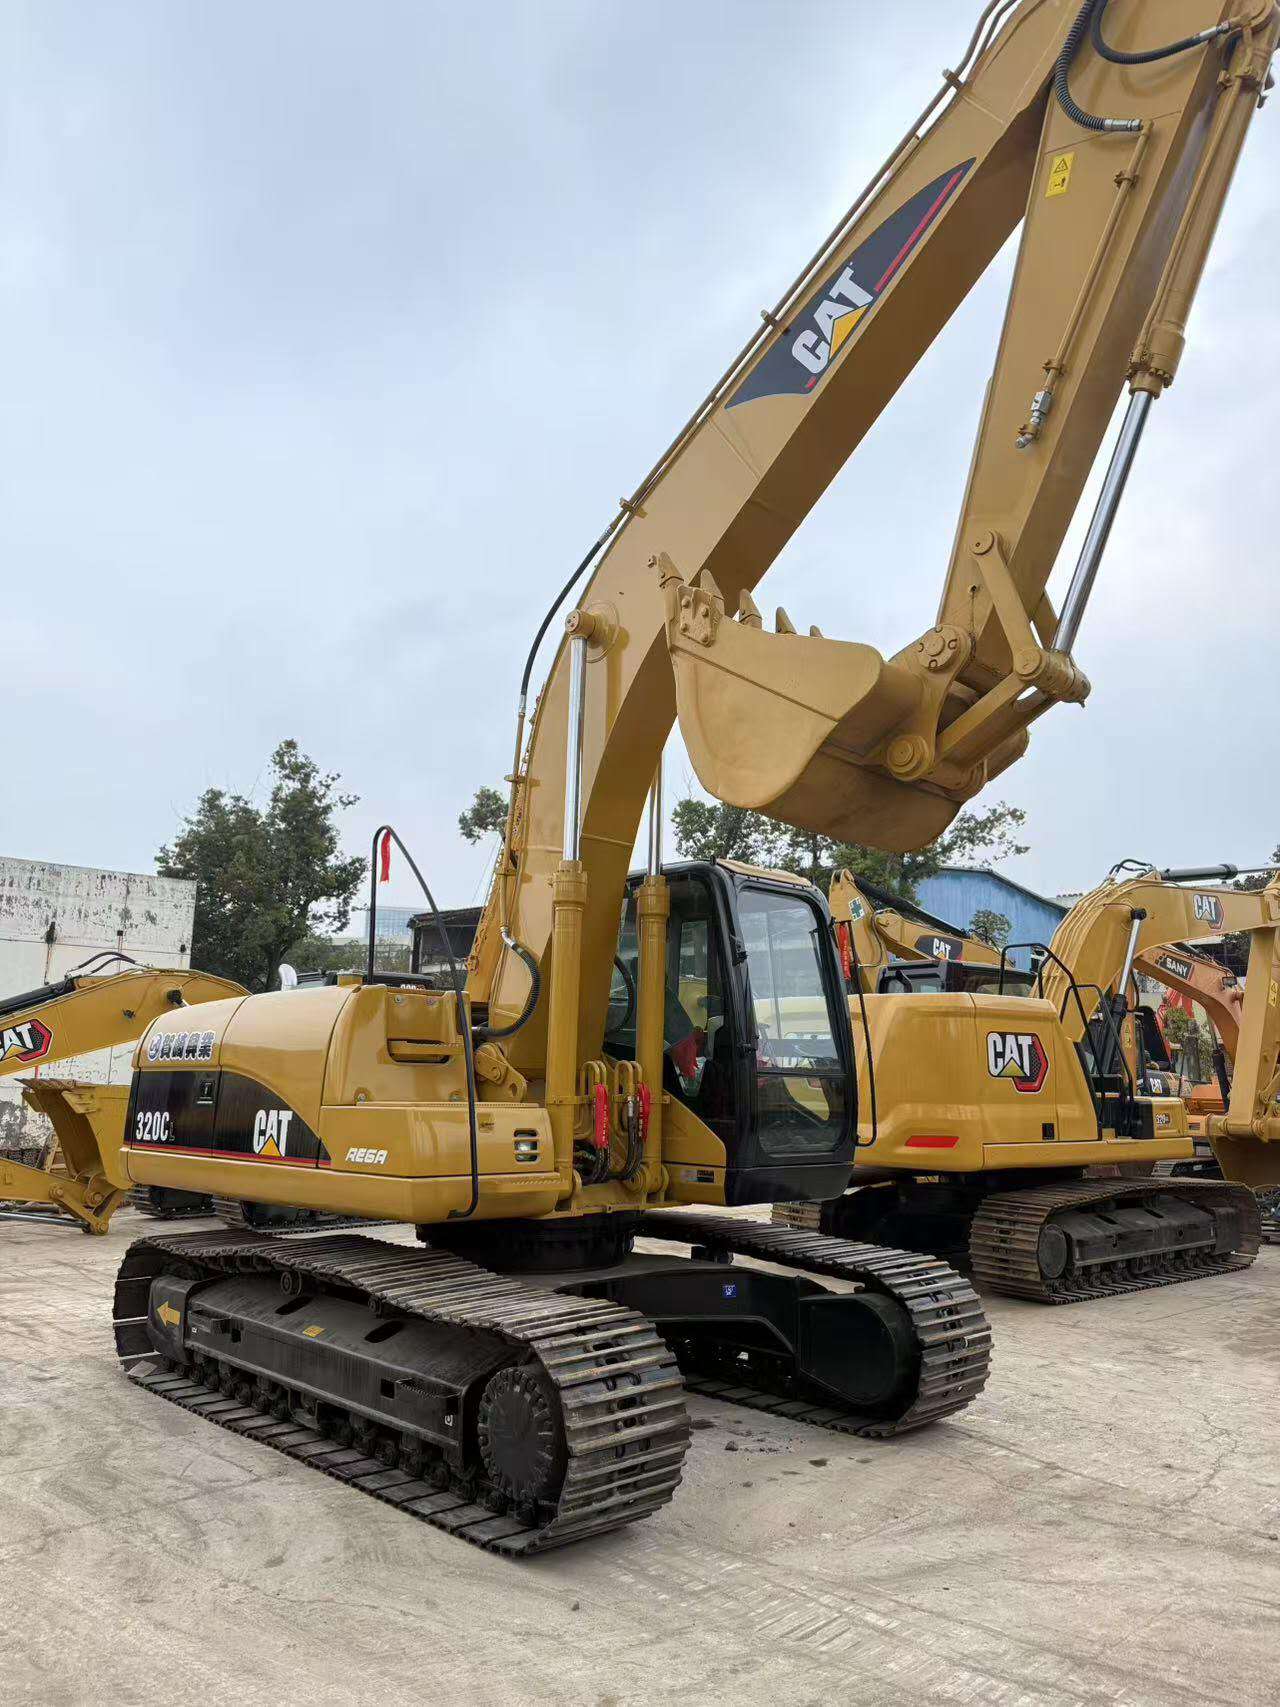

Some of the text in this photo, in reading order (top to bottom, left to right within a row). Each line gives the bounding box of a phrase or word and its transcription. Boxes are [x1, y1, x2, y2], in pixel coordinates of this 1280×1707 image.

[791, 266, 873, 374] CAT
[1193, 894, 1218, 920] CAT
[933, 937, 951, 959] CAT
[1165, 957, 1189, 977] SANY
[0, 1022, 34, 1060] AT
[987, 1031, 1032, 1077] CAT
[135, 1111, 170, 1141] 320C
[252, 1109, 294, 1158] CAT
